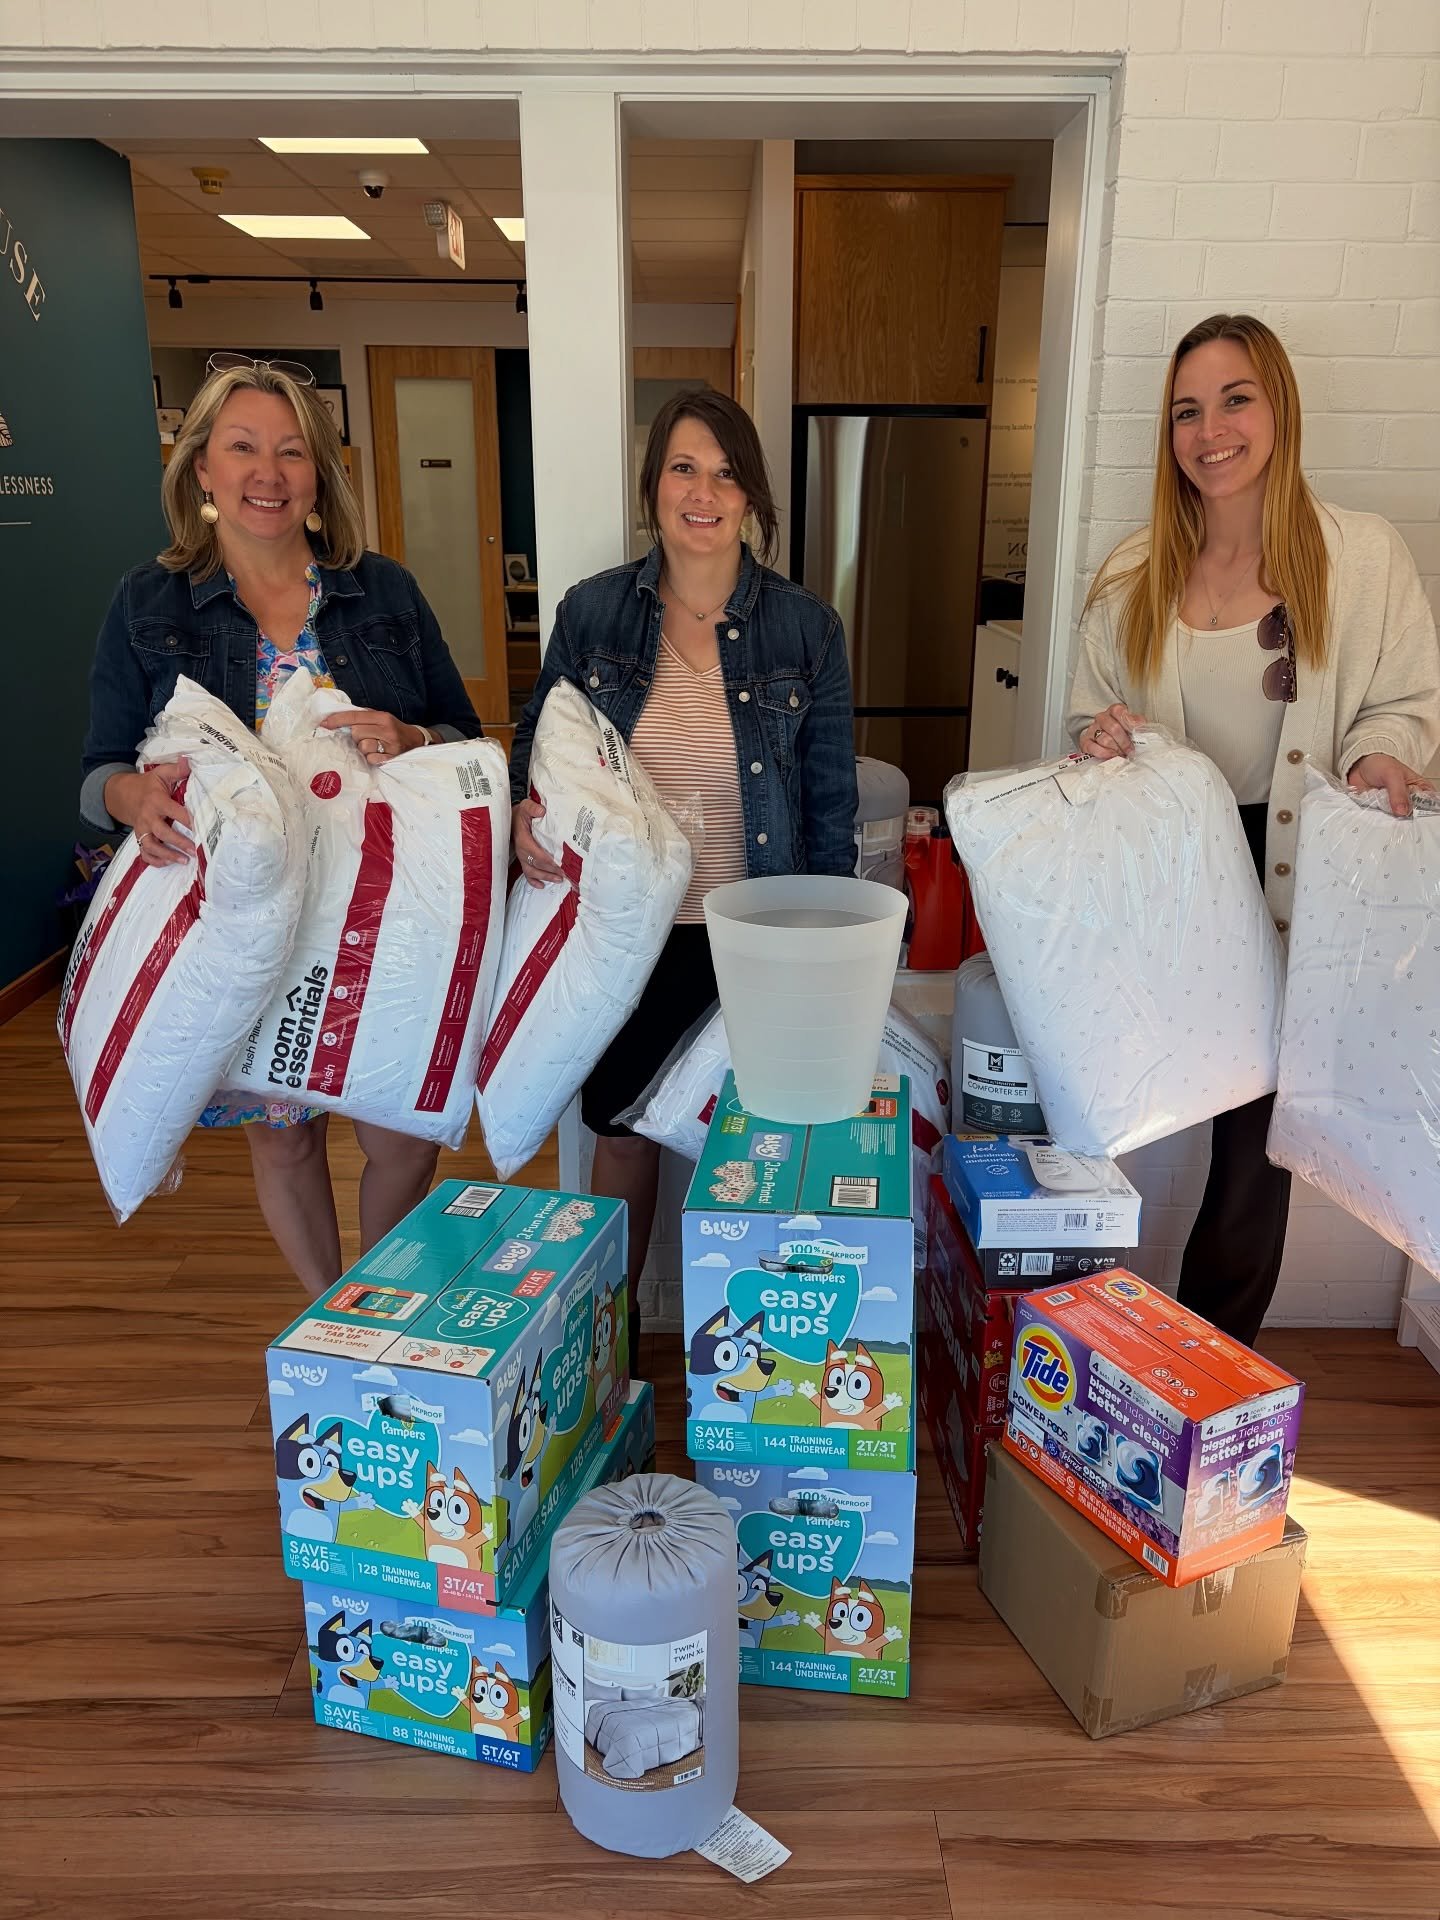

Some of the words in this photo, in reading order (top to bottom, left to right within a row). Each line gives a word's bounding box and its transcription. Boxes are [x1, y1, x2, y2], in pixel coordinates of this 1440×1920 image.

[286, 965, 328, 1088] essentials
[241, 1045, 256, 1076] Plush
[268, 1017, 297, 1085] room
[320, 1064, 336, 1091] Plush
[968, 1080, 1012, 1096] COMFORTER
[1014, 1089, 1028, 1097] SET
[764, 1167, 779, 1181] Fun
[522, 1218, 543, 1236] Fun
[536, 1196, 561, 1222] Prints!
[821, 1249, 866, 1260] LEAKPROOF
[519, 1271, 548, 1295] 3T/4T
[1108, 1280, 1140, 1297] Tide
[759, 1289, 838, 1316] easy
[1088, 1283, 1124, 1308] POWER
[457, 1295, 498, 1328] easy
[314, 1322, 342, 1331] PUSH
[359, 1328, 382, 1337] PULL
[324, 1330, 346, 1339] TAB
[768, 1313, 829, 1339] ups
[345, 1341, 369, 1349] OPEN
[553, 1329, 585, 1390] easy
[1021, 1340, 1070, 1395] Tide
[557, 1361, 583, 1415] ups
[1093, 1362, 1099, 1372] 4
[1119, 1379, 1132, 1397] 72
[1088, 1388, 1129, 1425] better
[1089, 1375, 1121, 1405] bigger
[1124, 1399, 1144, 1422] Tide
[1273, 1401, 1285, 1412] 144
[410, 1403, 443, 1420] AKPROOF
[1013, 1390, 1046, 1423] POWER
[1047, 1419, 1069, 1442] PODS
[1155, 1409, 1170, 1425] 144
[381, 1421, 426, 1441] Pampers
[694, 1426, 735, 1439] SAVE
[1206, 1425, 1214, 1436] 4
[1235, 1411, 1249, 1426] 72
[706, 1438, 735, 1452] $40
[763, 1436, 787, 1448] 144
[789, 1435, 833, 1446] TRAINING
[856, 1440, 897, 1454] 2T/3T
[1200, 1441, 1245, 1468] better
[1248, 1427, 1287, 1449] clean.
[1202, 1434, 1237, 1454] bigger
[1239, 1424, 1259, 1438] Tide
[347, 1437, 420, 1470] easy
[789, 1445, 846, 1456] UNDERWEAR
[356, 1462, 414, 1489] ups
[1083, 1466, 1108, 1490] ODOR
[827, 1496, 870, 1507] LEAKPROOF
[504, 1533, 533, 1588] SAVE
[541, 1483, 560, 1526] $40
[570, 1449, 584, 1480] 128
[289, 1540, 329, 1559] SAVE
[769, 1530, 843, 1555] easy
[291, 1560, 301, 1568] TO
[301, 1555, 330, 1573] $40
[357, 1562, 379, 1577] 128
[381, 1564, 420, 1579] TRAINING
[776, 1552, 834, 1574] ups
[382, 1574, 432, 1591] UNDERWEAR
[443, 1576, 485, 1595] 3T/4T
[673, 1642, 695, 1655] TWIN
[673, 1652, 695, 1664] TWIN
[392, 1652, 453, 1679] easy
[770, 1661, 792, 1672] 144
[795, 1660, 836, 1671] TRAINING
[795, 1669, 848, 1681] UNDERWEAR
[858, 1667, 896, 1681] 2T/3T
[401, 1670, 448, 1695] ups
[324, 1704, 361, 1722] SAVE
[392, 1726, 408, 1739] 88
[412, 1728, 455, 1745] TRAINING
[413, 1737, 468, 1757] UNDERWEAR
[482, 1744, 521, 1762] 5T/6T
